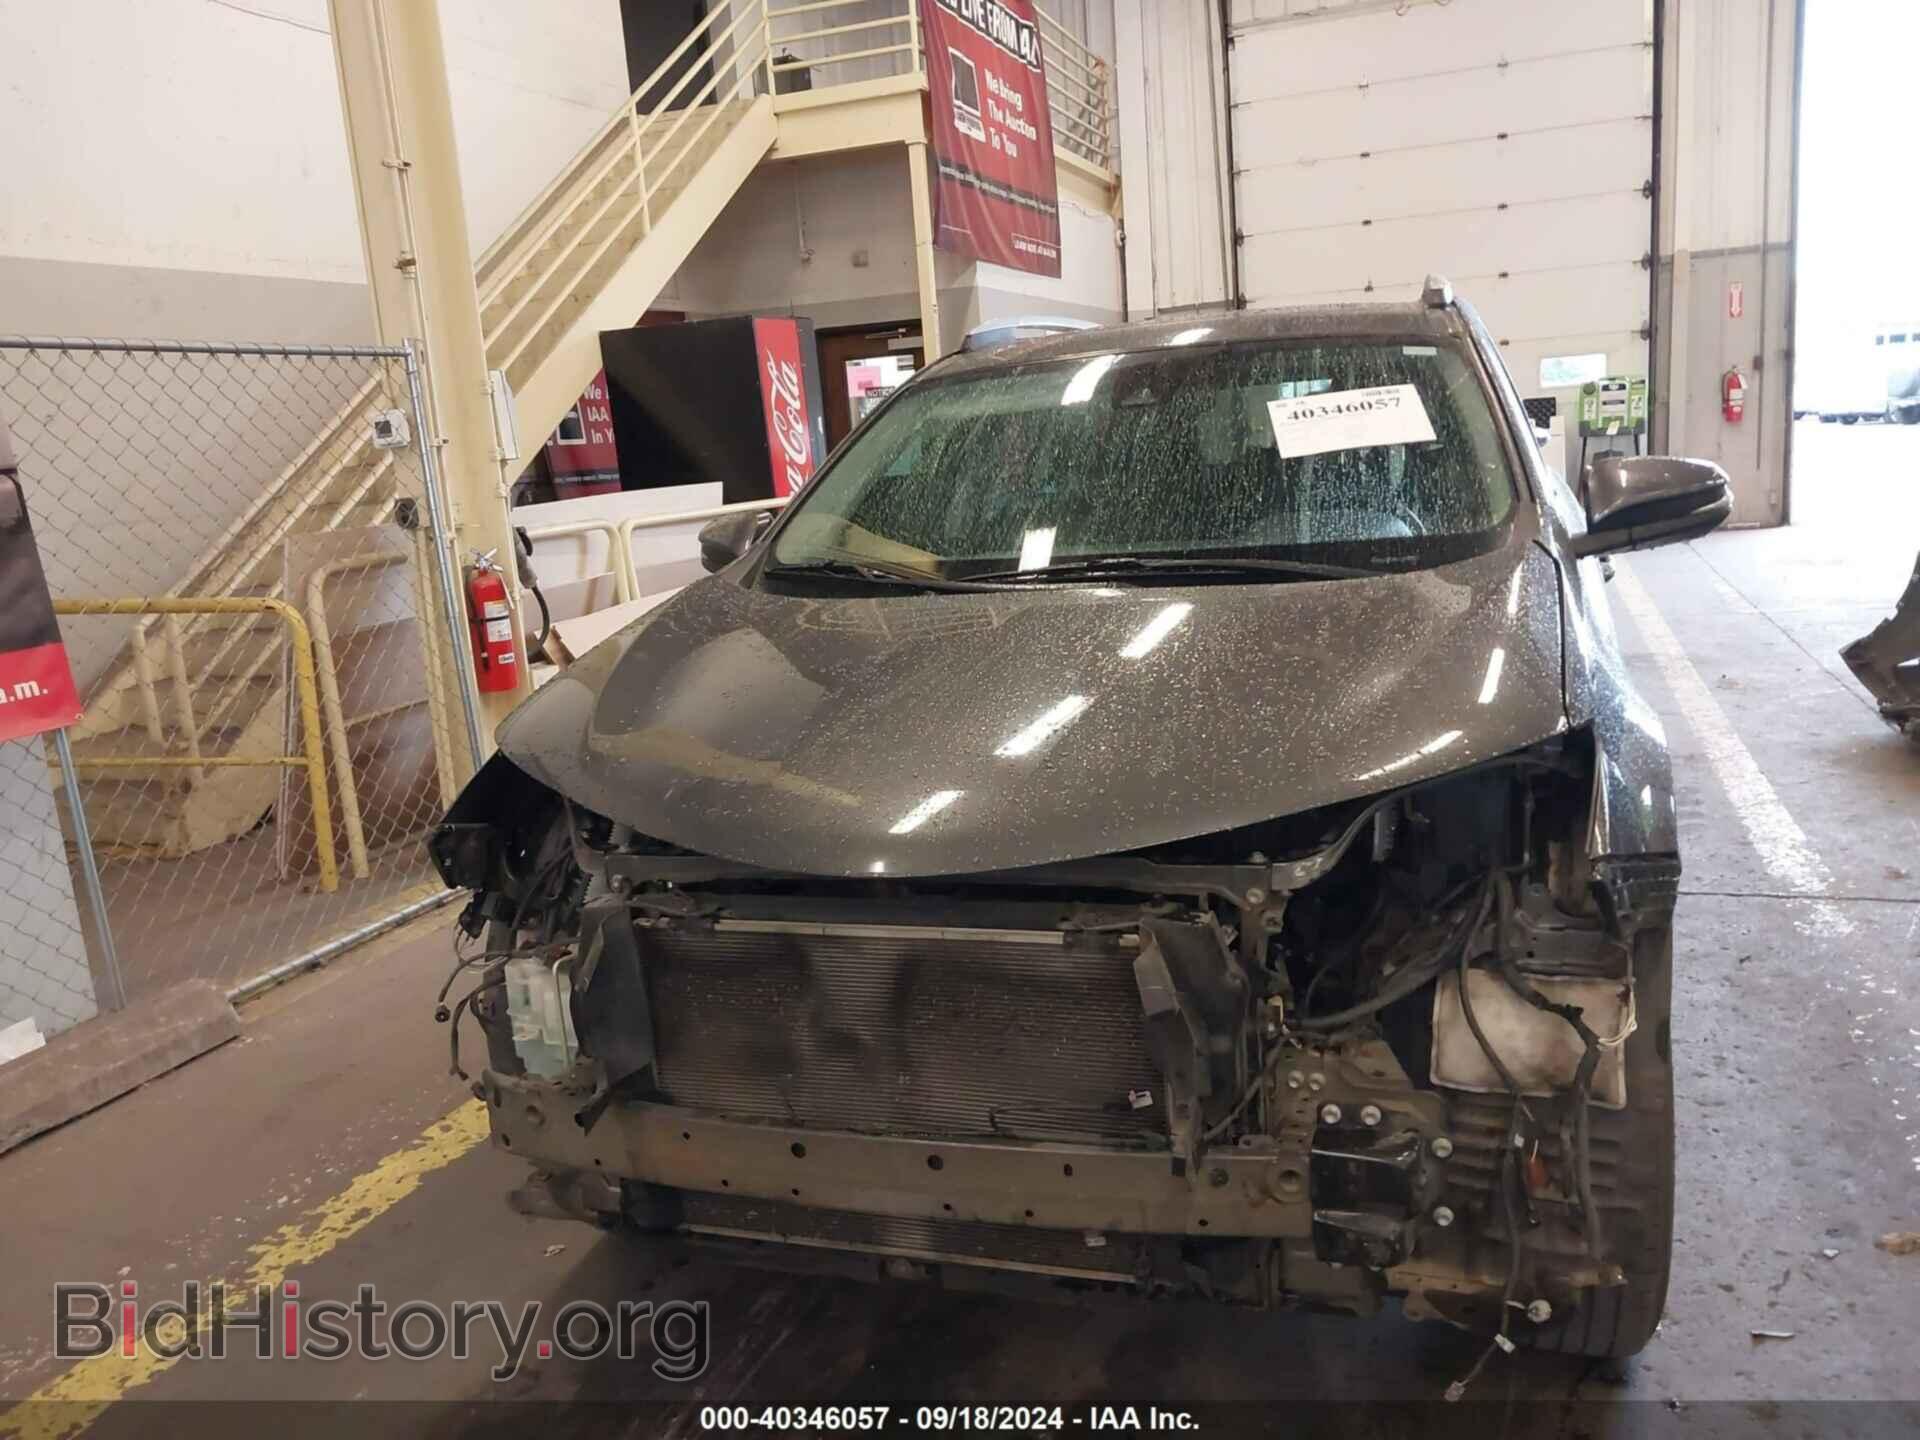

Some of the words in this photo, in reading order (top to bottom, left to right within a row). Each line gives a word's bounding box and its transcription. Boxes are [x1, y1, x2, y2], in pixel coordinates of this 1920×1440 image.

[587, 406, 610, 422] IAA
[1288, 397, 1401, 421] 40346057
[591, 428, 604, 444] In
